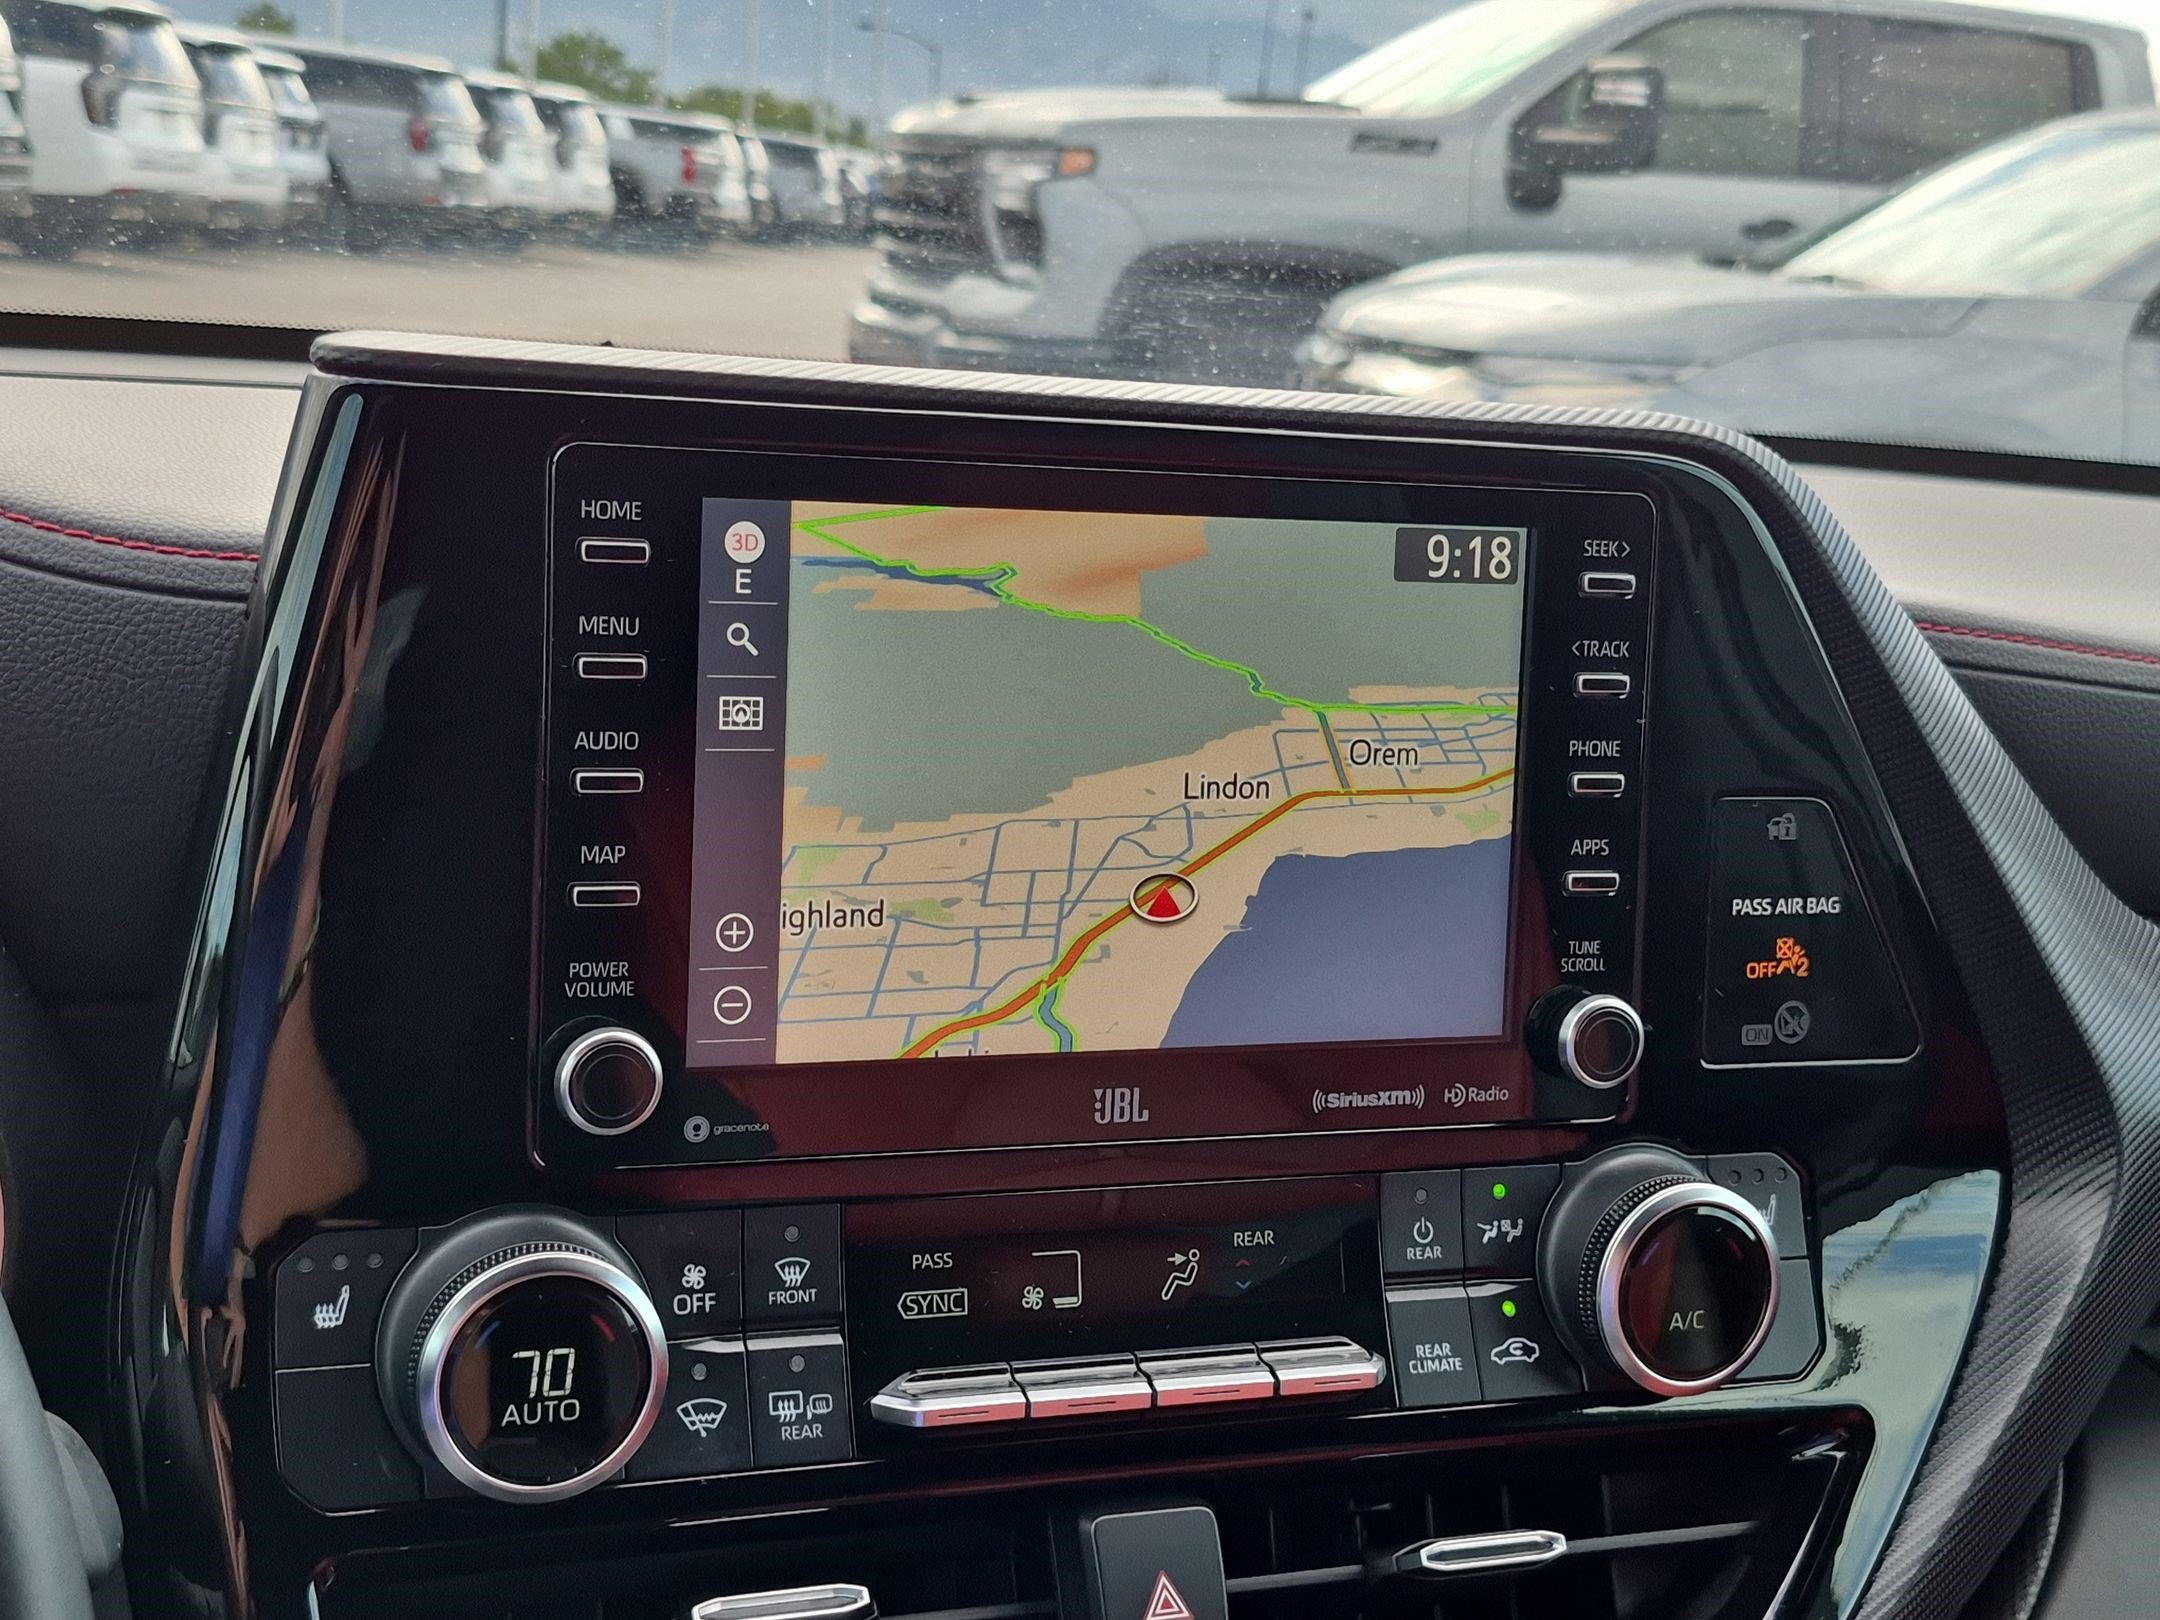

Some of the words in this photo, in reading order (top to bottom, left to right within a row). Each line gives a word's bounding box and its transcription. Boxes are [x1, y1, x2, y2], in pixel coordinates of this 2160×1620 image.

[581, 500, 642, 521] HOME
[731, 533, 759, 552] 3D
[1426, 534, 1513, 580] 9:18
[735, 568, 752, 594] E
[578, 616, 640, 636] MENU
[574, 731, 640, 751] AUDIO
[1569, 740, 1621, 758] PHONE
[1348, 738, 1419, 769] Orem
[1183, 772, 1270, 801] Lindon
[580, 845, 626, 865] MAP
[1570, 839, 1610, 857] APPS
[1731, 897, 1771, 916] PASS
[1774, 897, 1804, 916] AIR
[1806, 896, 1842, 915] BAG
[781, 898, 884, 936] ighland
[1567, 940, 1601, 955] TUNE
[569, 961, 630, 978] POWER
[1560, 957, 1606, 972] SCROLL
[1746, 961, 1777, 979] OFF
[1796, 957, 1809, 977] 2
[564, 980, 636, 998] VOLUME
[1444, 1083, 1466, 1108] HD
[1468, 1086, 1509, 1103] Radio
[1093, 1087, 1149, 1125] JBL
[713, 1122, 770, 1136] gracenote
[1233, 1230, 1275, 1248] REAR
[912, 1252, 954, 1270] PASS
[1406, 1245, 1443, 1261] REAR
[673, 1293, 717, 1316] OFF
[768, 1288, 818, 1305] FRONT
[905, 1296, 965, 1316] SYNC
[1669, 1310, 1706, 1331] A/C
[1415, 1342, 1452, 1360] REAR
[511, 1346, 577, 1399] 70
[1408, 1357, 1464, 1374] CLIMATE
[501, 1399, 581, 1428] AUTO
[780, 1423, 824, 1441] REAR
